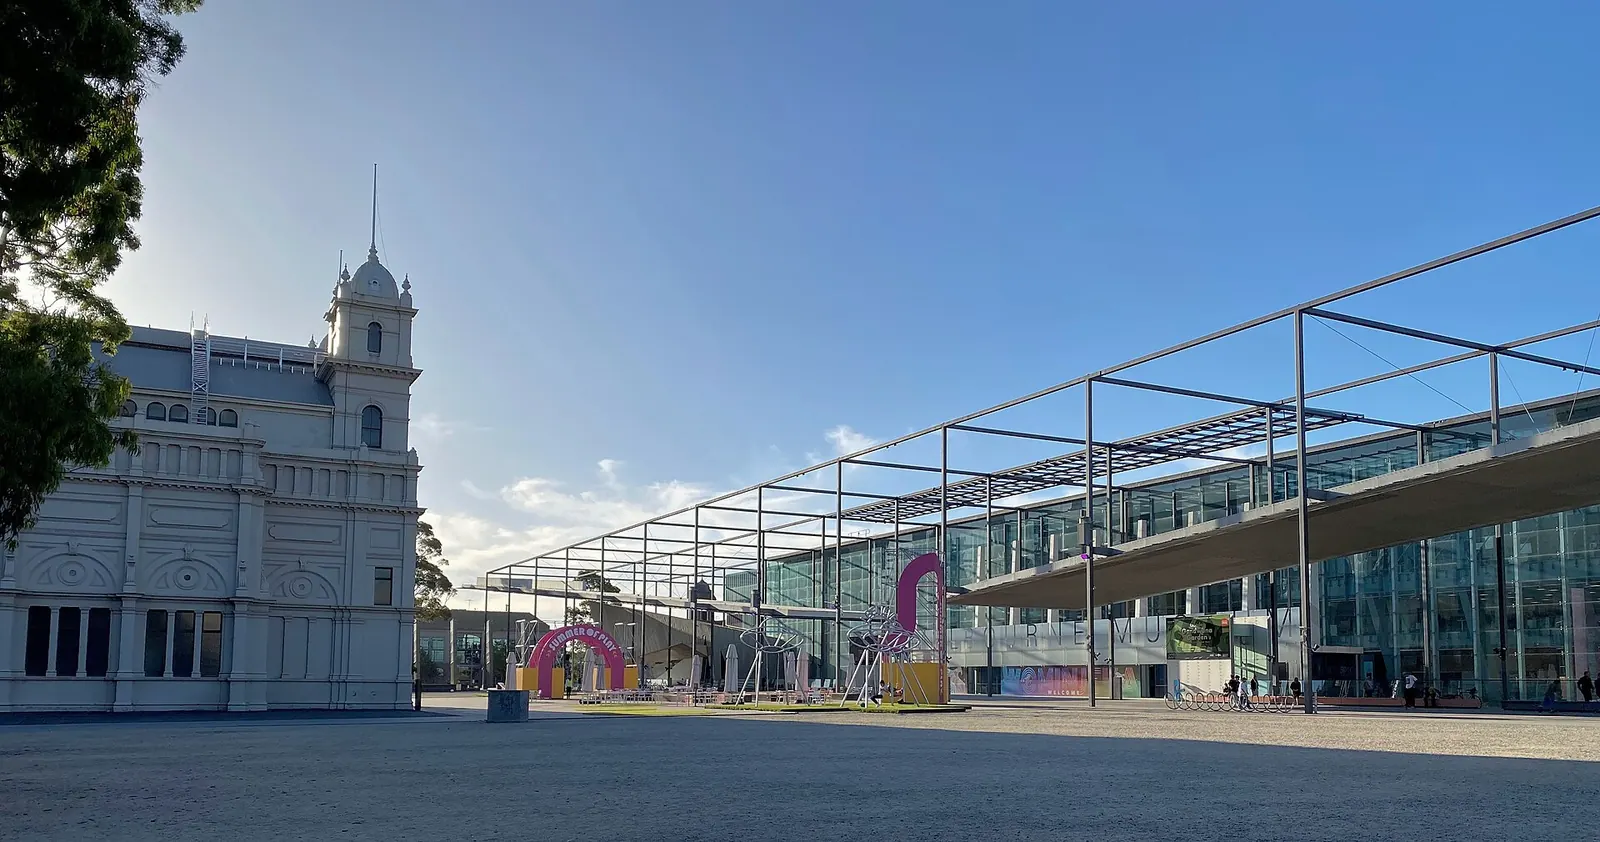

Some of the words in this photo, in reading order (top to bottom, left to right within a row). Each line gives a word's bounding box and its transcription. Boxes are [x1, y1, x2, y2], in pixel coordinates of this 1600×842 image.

[549, 627, 585, 651] SUMMER
[586, 628, 600, 638] OF
[598, 633, 617, 652] PLAY
